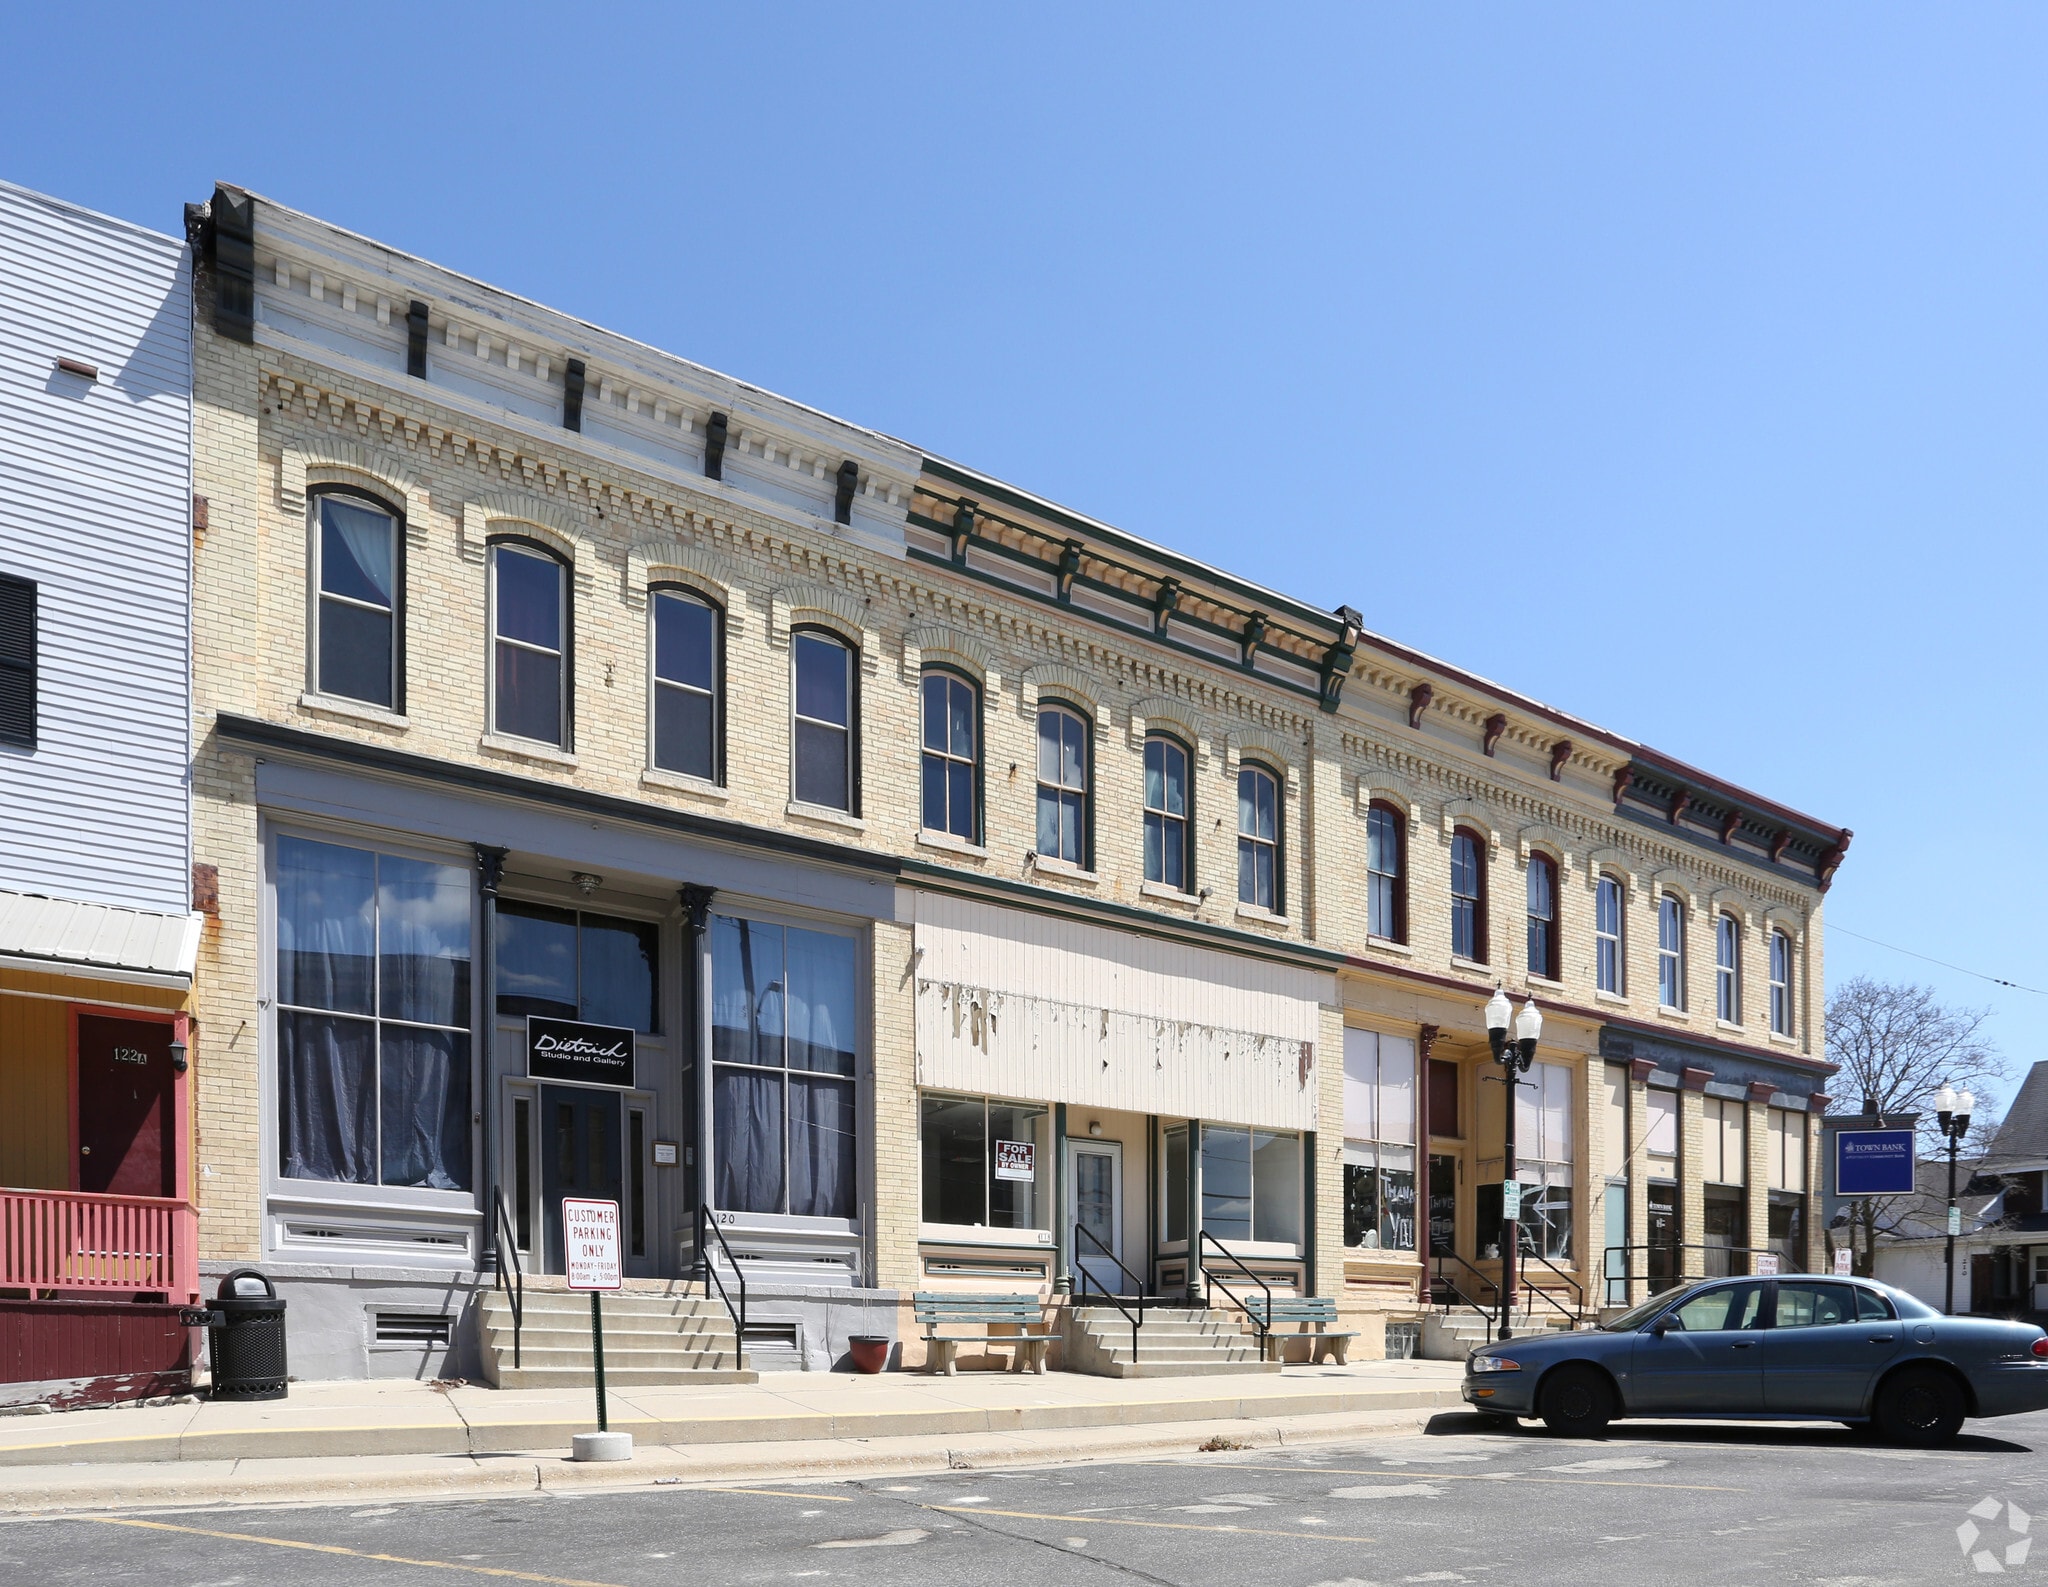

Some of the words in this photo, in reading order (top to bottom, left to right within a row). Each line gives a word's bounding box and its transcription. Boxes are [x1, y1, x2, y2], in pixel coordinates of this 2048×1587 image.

[534, 1034, 628, 1058] Dietrich
[113, 1047, 147, 1064] 122A
[541, 1050, 571, 1060] Studio
[573, 1055, 591, 1063] and
[593, 1056, 626, 1067] Gallery
[1003, 1144, 1028, 1154] FOR
[1855, 1144, 1880, 1152] TOWN
[1881, 1143, 1906, 1152] BANK
[998, 1152, 1032, 1165] SALE
[1010, 1162, 1029, 1170] OWNER
[568, 1209, 615, 1224] CUSTOMER
[717, 1213, 735, 1224] 120
[573, 1226, 612, 1241] PARKING
[582, 1244, 605, 1257] ONLY
[600, 1272, 619, 1282] 5:00pm
